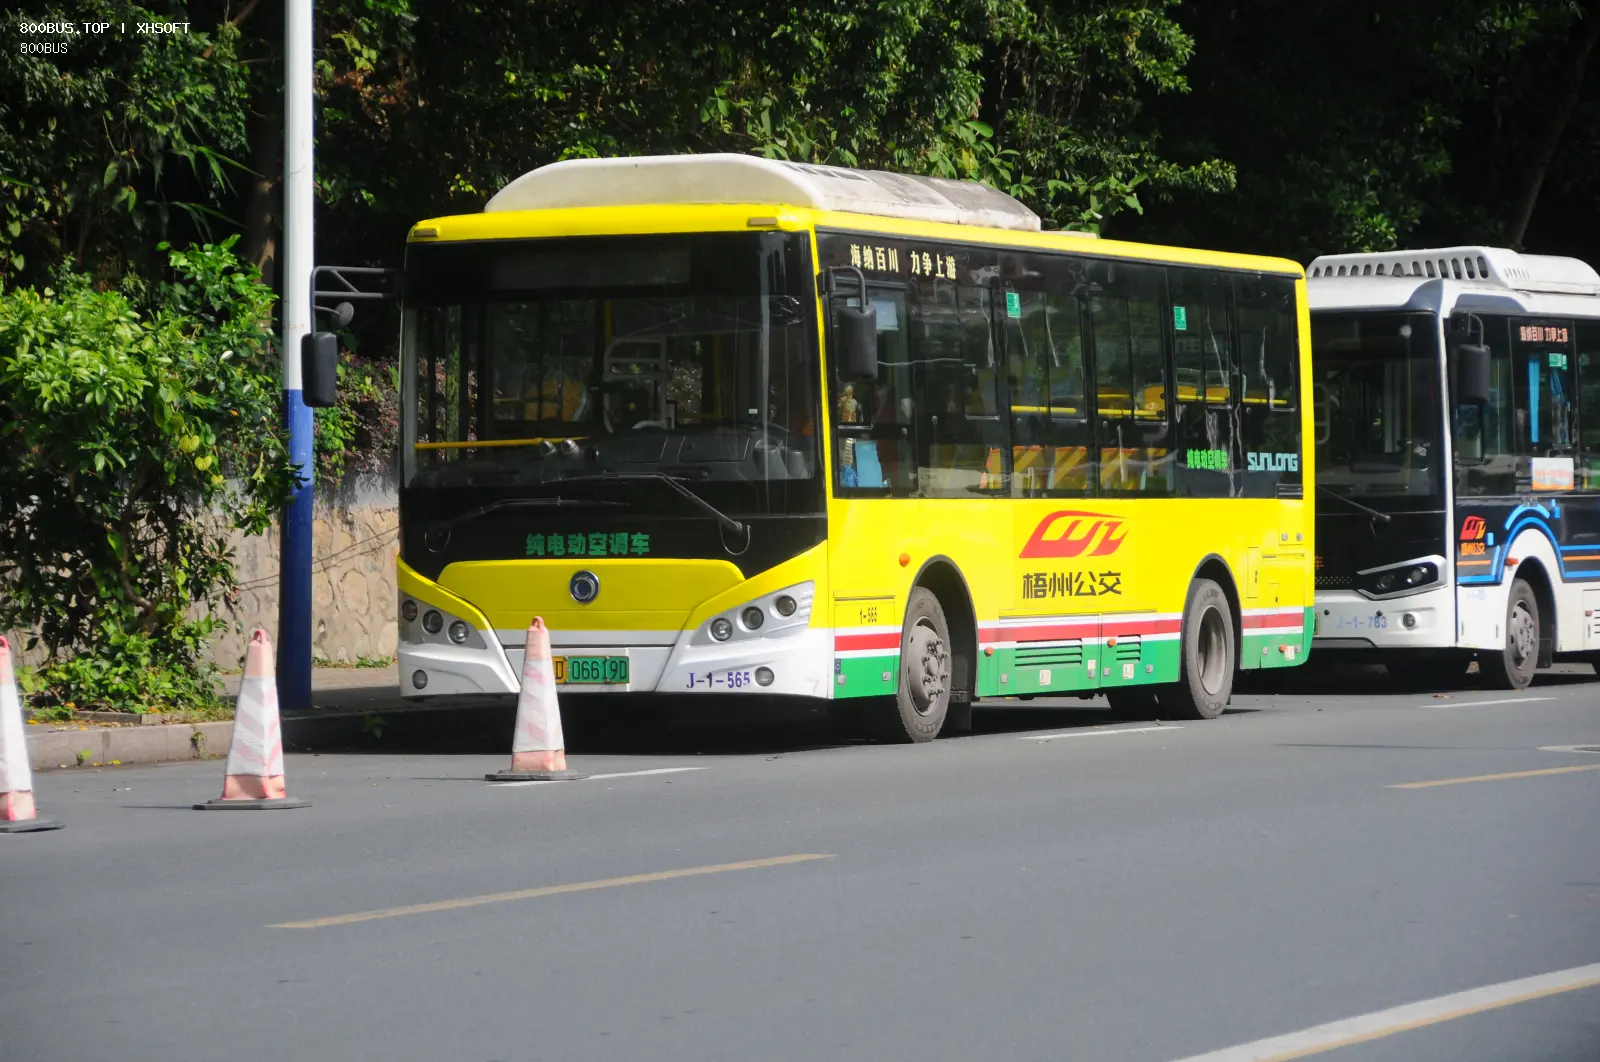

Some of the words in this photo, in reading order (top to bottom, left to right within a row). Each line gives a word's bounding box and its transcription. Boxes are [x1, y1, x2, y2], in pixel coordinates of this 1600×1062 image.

[850, 244, 899, 273] 海纳百川
[910, 251, 957, 280] 力争上游
[526, 532, 649, 556] 纯电动空调车
[1022, 570, 1122, 599] 梧州公交
[686, 671, 751, 689] J-1-565
